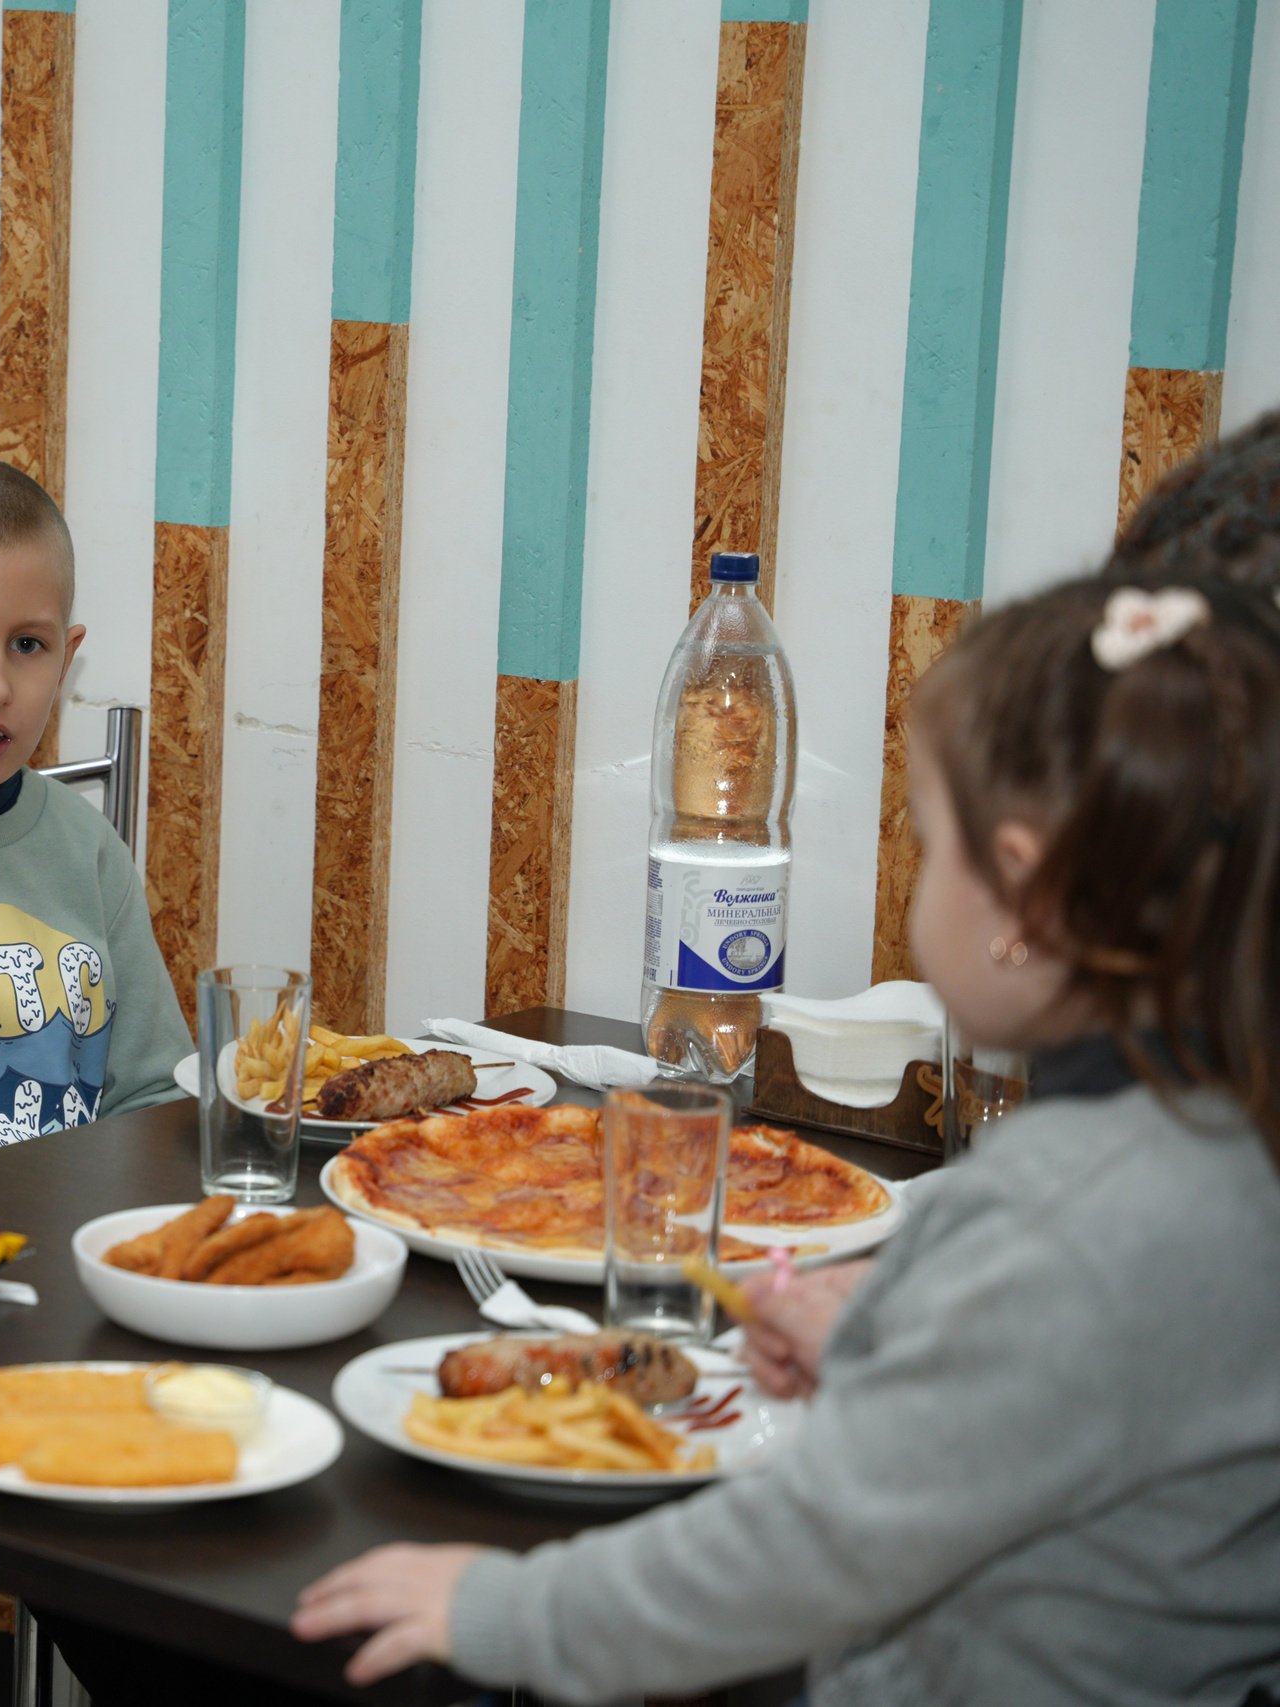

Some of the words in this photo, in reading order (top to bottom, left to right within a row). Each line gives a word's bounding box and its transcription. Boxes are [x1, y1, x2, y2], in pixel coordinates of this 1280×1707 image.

[714, 889, 776, 907] Волжанка
[707, 907, 781, 919] МИНЕРАЛЬНАЯ
[714, 917, 777, 926] ЛЕЧЕБНО-СТОЛОВАЯ
[722, 931, 748, 949] UNDORY
[750, 930, 770, 947] SPRINGS
[721, 957, 745, 975] UNDORY
[747, 956, 769, 975] SPRINGS
